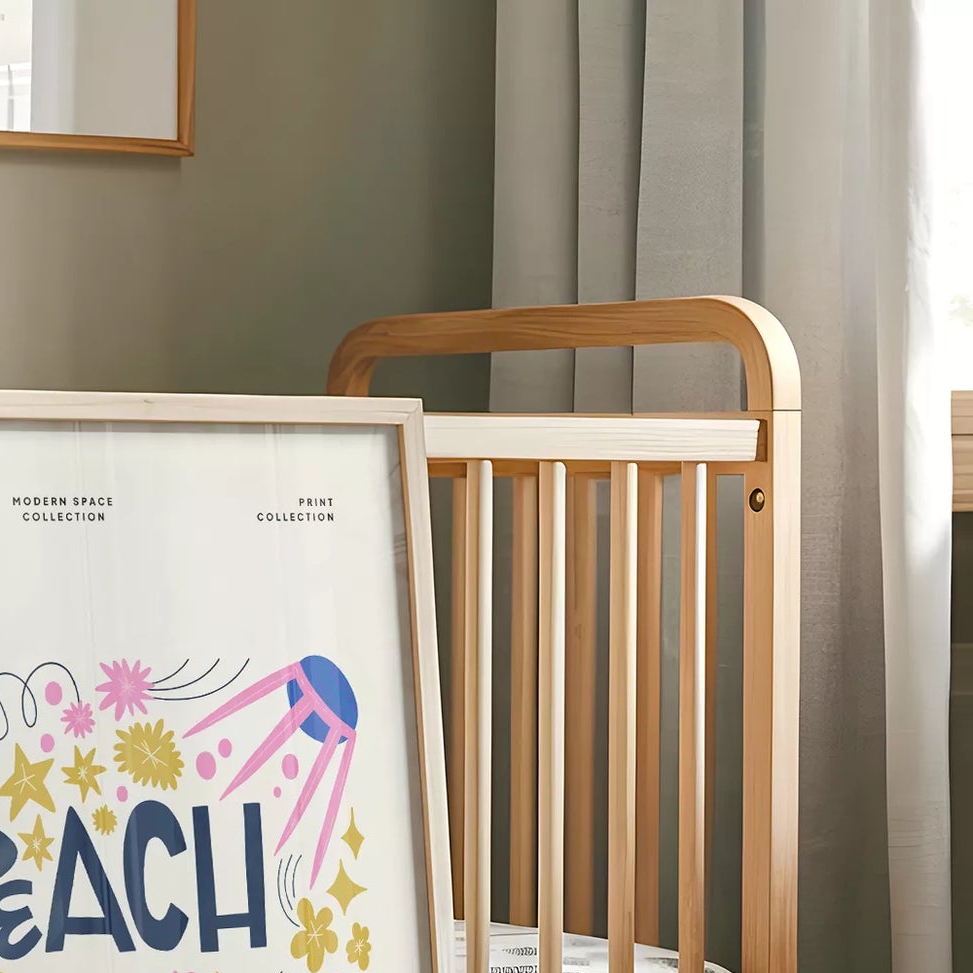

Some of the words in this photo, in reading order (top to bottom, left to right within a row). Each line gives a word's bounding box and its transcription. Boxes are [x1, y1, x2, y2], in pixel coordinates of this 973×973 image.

[12, 496, 67, 506] MODERN
[72, 496, 114, 506] SPACE
[298, 497, 334, 507] PRINT
[22, 512, 106, 522] COLLECTION
[256, 512, 335, 522] COLLECTION
